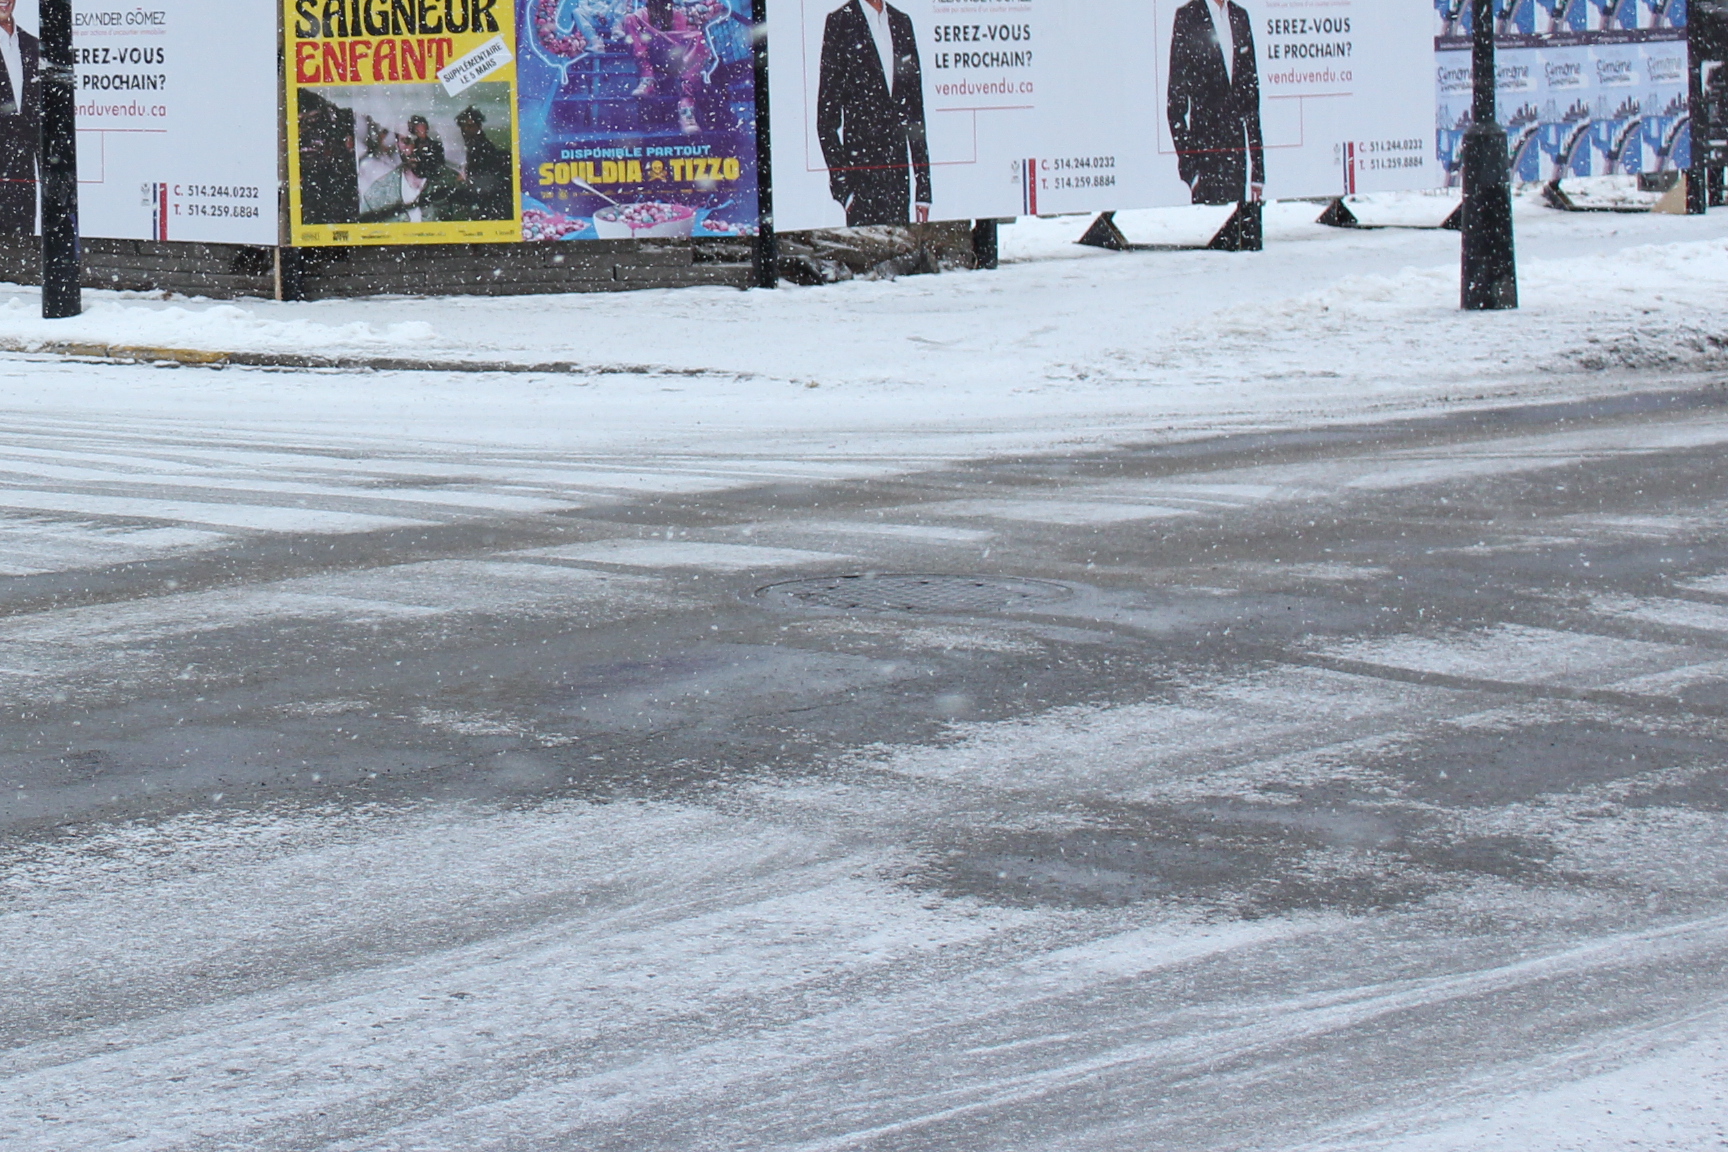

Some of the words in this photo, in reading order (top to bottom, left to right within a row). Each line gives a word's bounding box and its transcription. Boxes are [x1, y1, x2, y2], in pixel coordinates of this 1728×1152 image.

[72, 12, 122, 26] EXANDER
[1267, 17, 1351, 35] SEREZ-VOUS
[934, 24, 1031, 42] SEREZ-VOUS
[73, 47, 165, 64] EREZ-VOUS
[1268, 45, 1280, 59] LE
[1284, 42, 1352, 59] PROCHAIN?
[295, 38, 453, 83] ENFANT
[443, 41, 503, 83] SUPPLÉMENTAIRE
[935, 53, 949, 69] LE
[954, 50, 1032, 69] PROCHAIN?
[459, 74, 470, 85] LE
[477, 58, 498, 77] MARS
[1268, 67, 1352, 84] venduvendu.ca
[83, 74, 166, 90] PROCHAIN?
[935, 77, 1033, 95] venduvendu.ca
[74, 100, 166, 117] enduvendu.ca
[561, 147, 642, 160] DISPONIBLE
[646, 145, 711, 157] PARTOUT
[539, 159, 642, 185] SOULDIA
[670, 157, 740, 181] TIZZO
[1054, 157, 1116, 170] 514.244.0232
[188, 185, 259, 198] 514.244.0232
